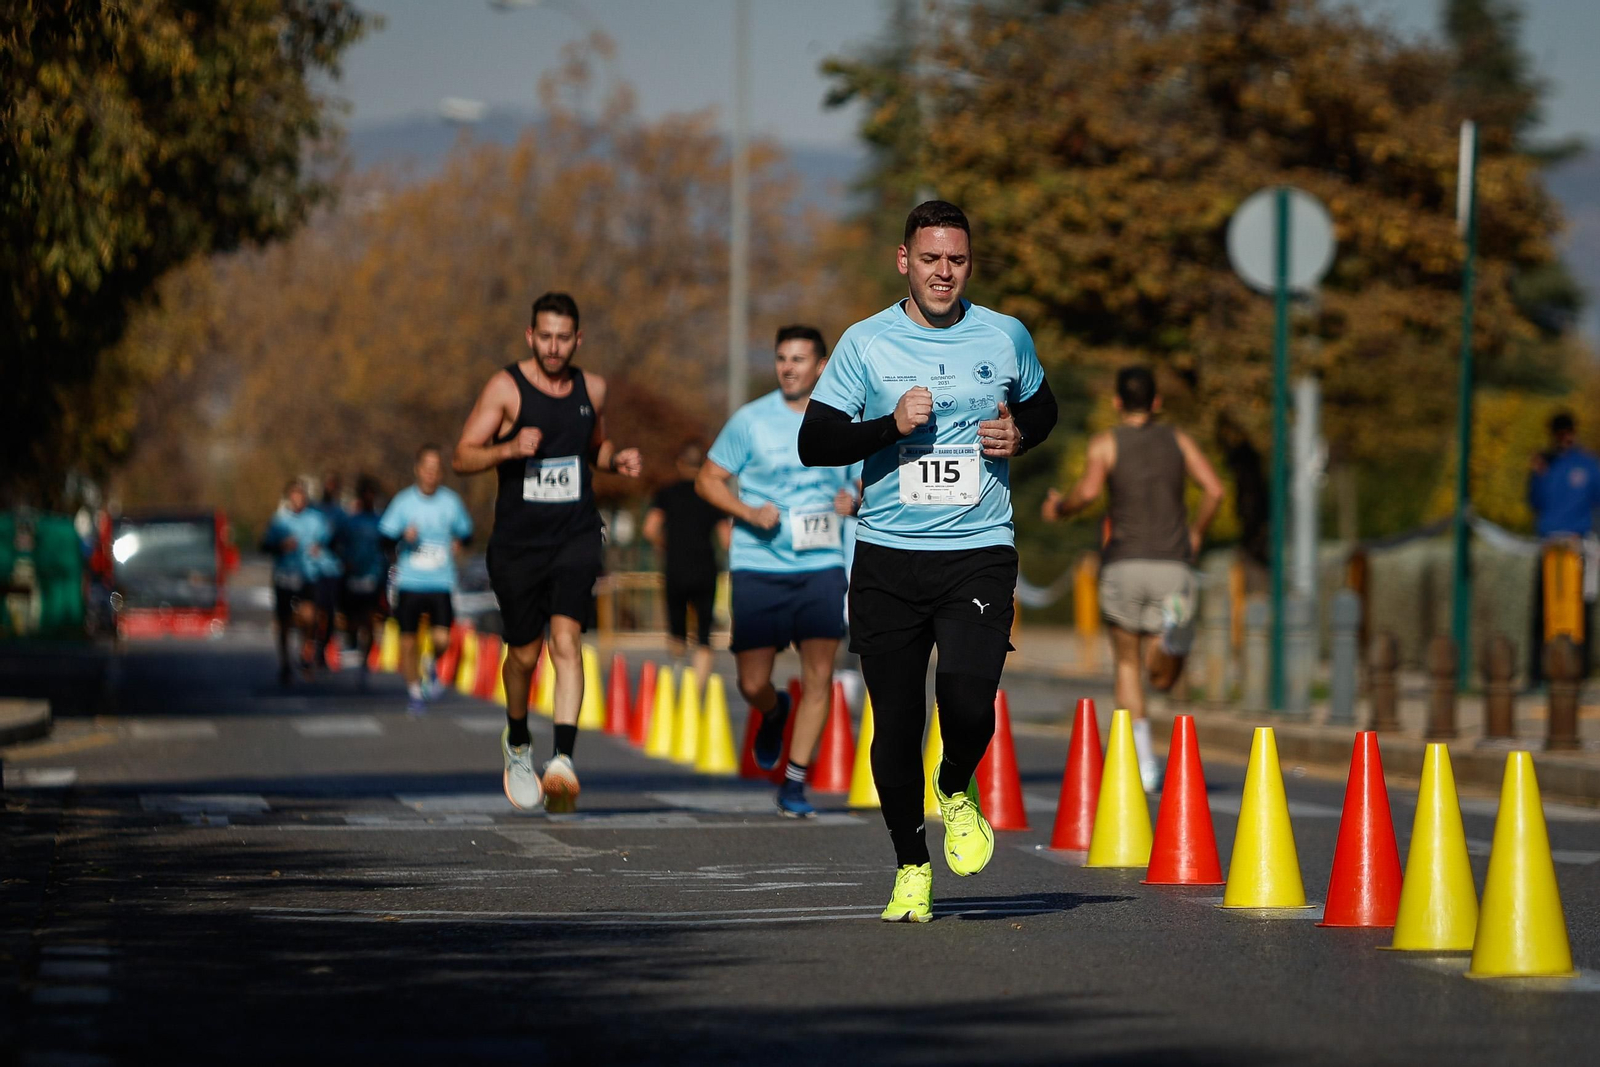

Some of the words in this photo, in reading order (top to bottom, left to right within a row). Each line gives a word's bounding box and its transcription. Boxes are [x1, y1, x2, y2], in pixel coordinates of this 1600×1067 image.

[536, 467, 569, 487] 146
[918, 460, 960, 483] 115
[803, 516, 829, 534] 173
